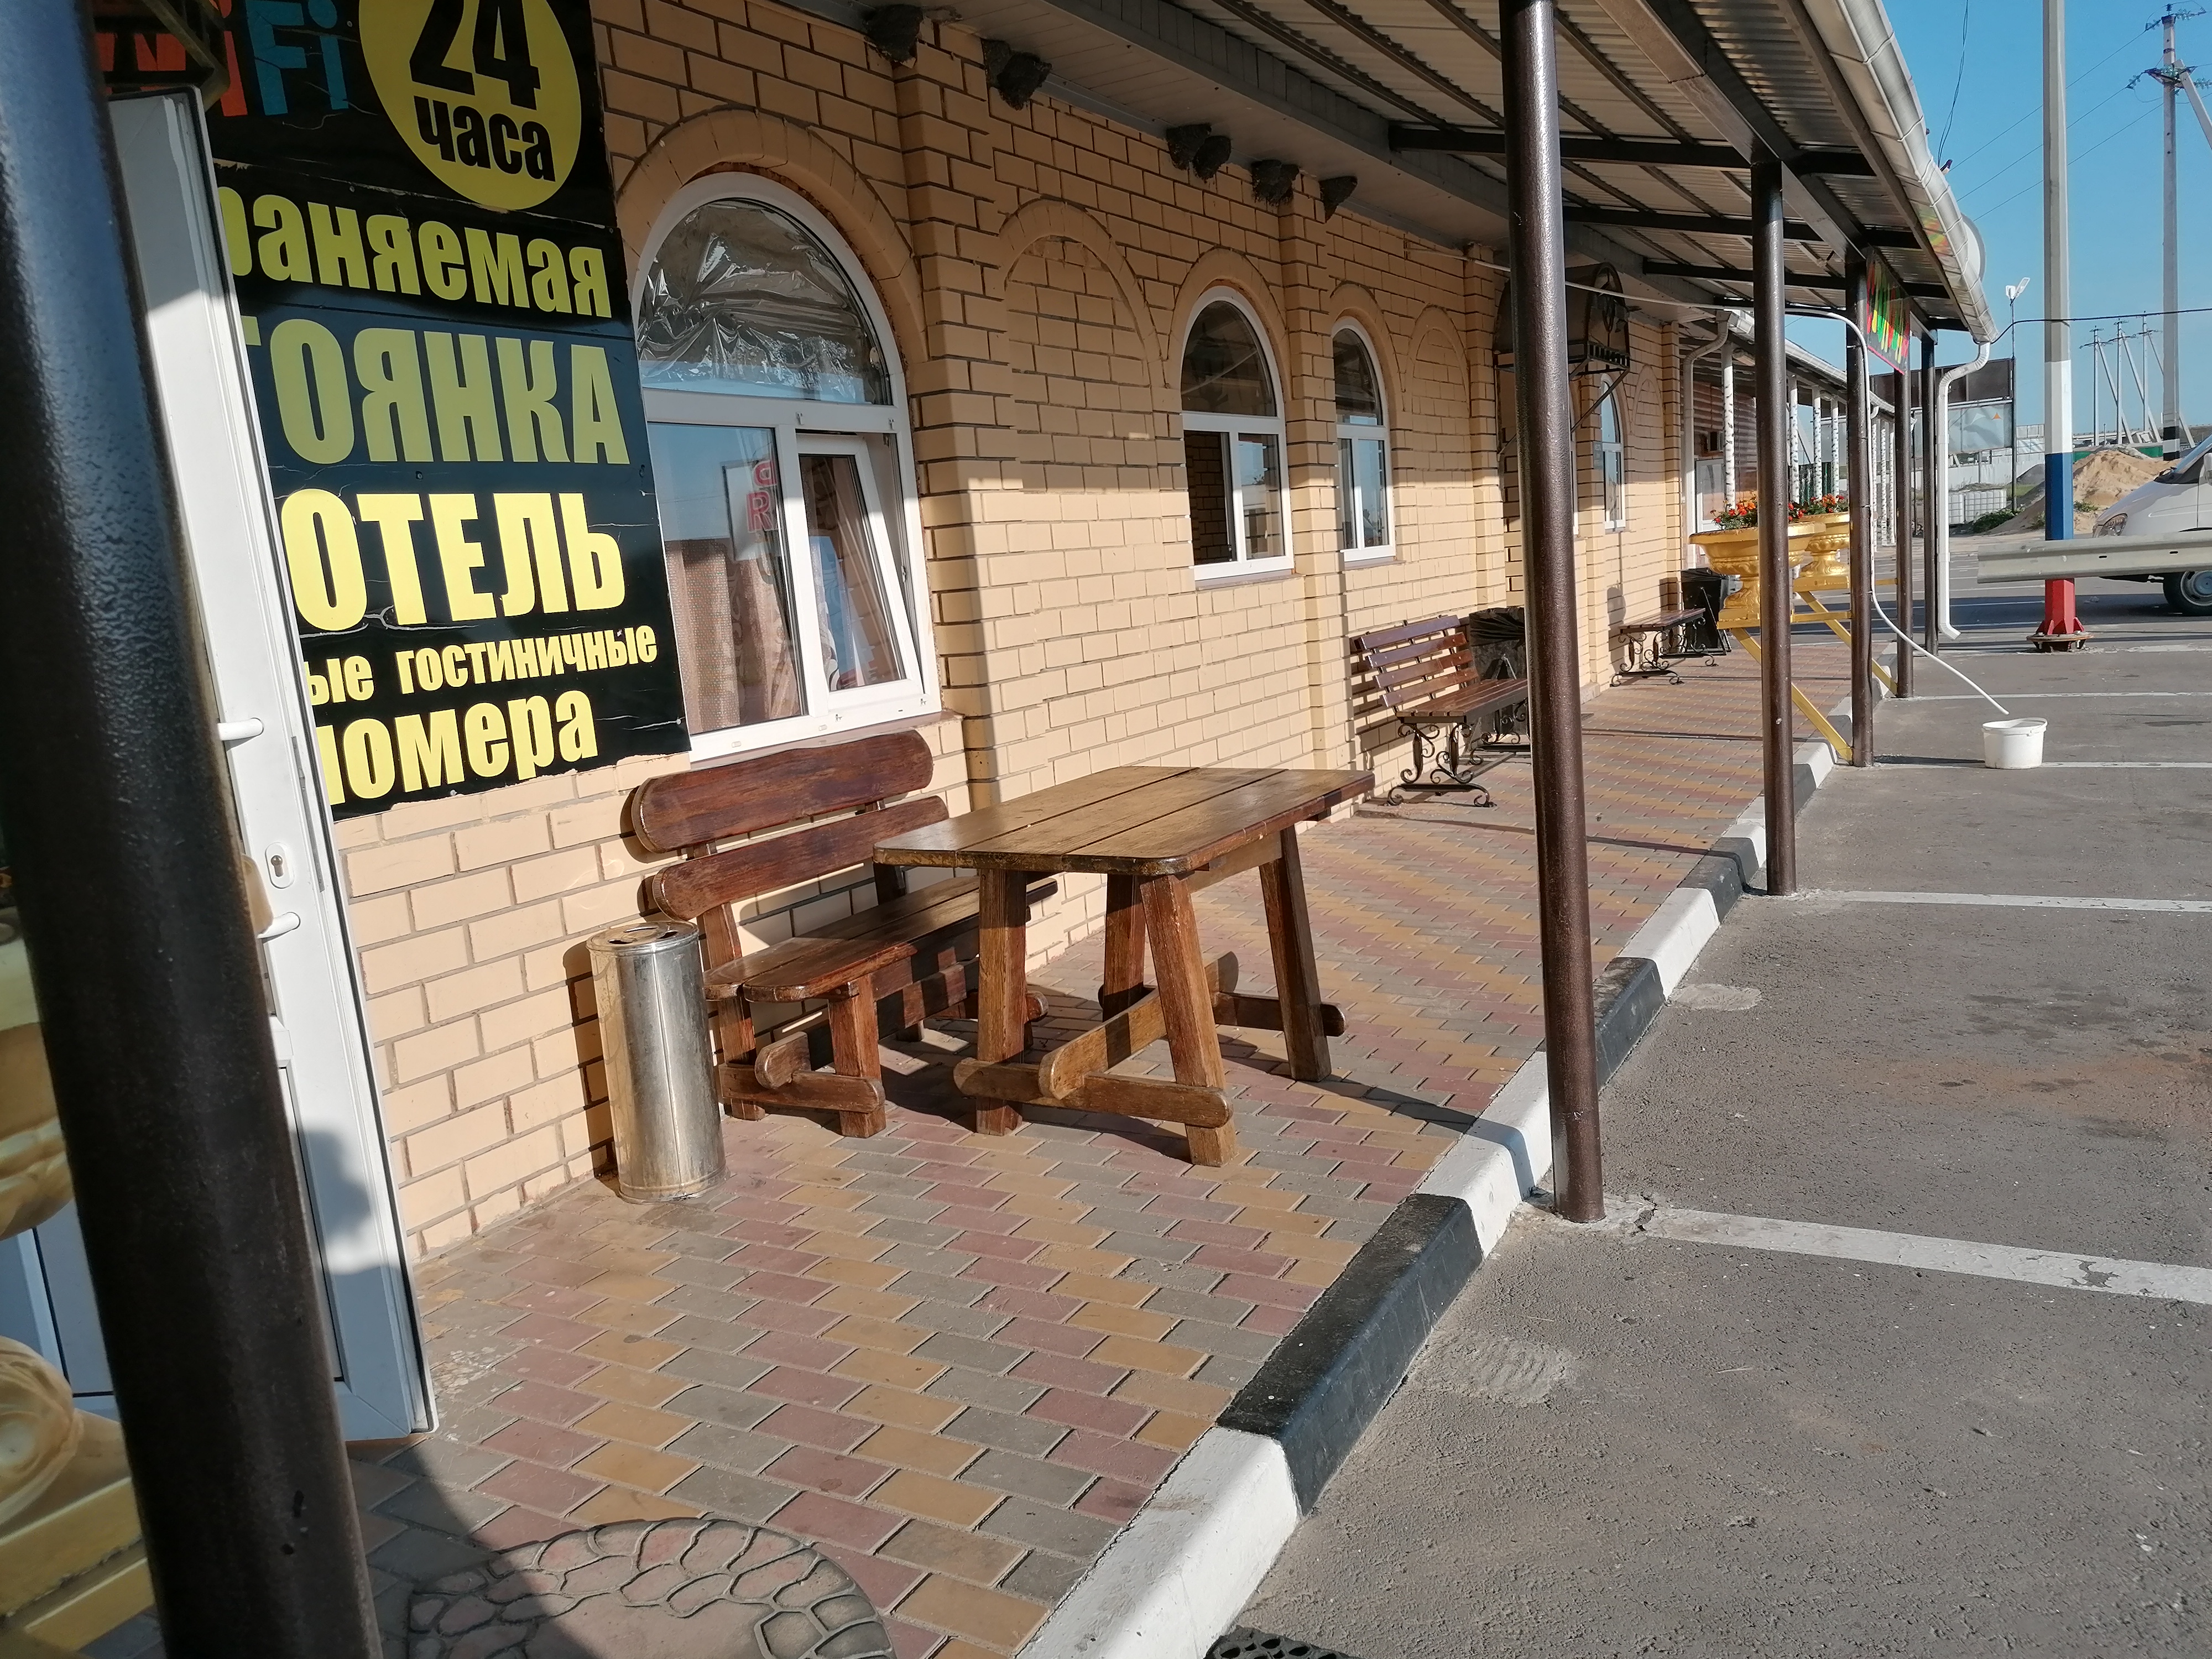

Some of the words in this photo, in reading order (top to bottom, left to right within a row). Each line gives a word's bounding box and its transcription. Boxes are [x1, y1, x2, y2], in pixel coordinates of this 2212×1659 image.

[409, 0, 540, 110] 24
[413, 95, 556, 182] часа
[241, 315, 629, 465] ОЯНКА
[280, 488, 625, 632] ОТЕЛЬ
[395, 625, 657, 695] гостиничные
